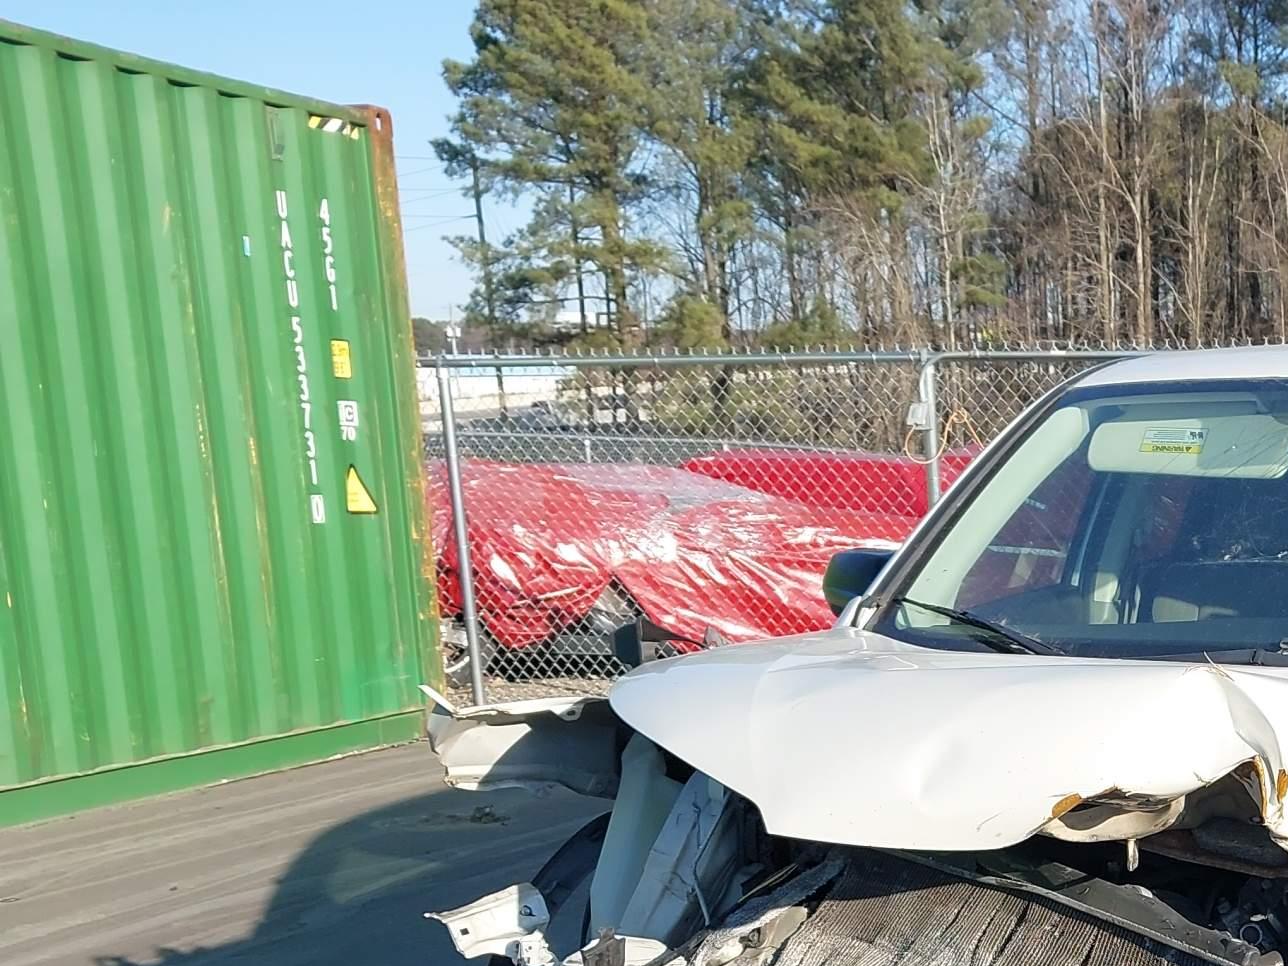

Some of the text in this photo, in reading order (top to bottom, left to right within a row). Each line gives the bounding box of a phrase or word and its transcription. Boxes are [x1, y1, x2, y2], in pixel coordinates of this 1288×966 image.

[319, 198, 338, 311] 45G1
[275, 190, 298, 308] UACU
[291, 316, 318, 485] 533731
[339, 425, 358, 441] 70
